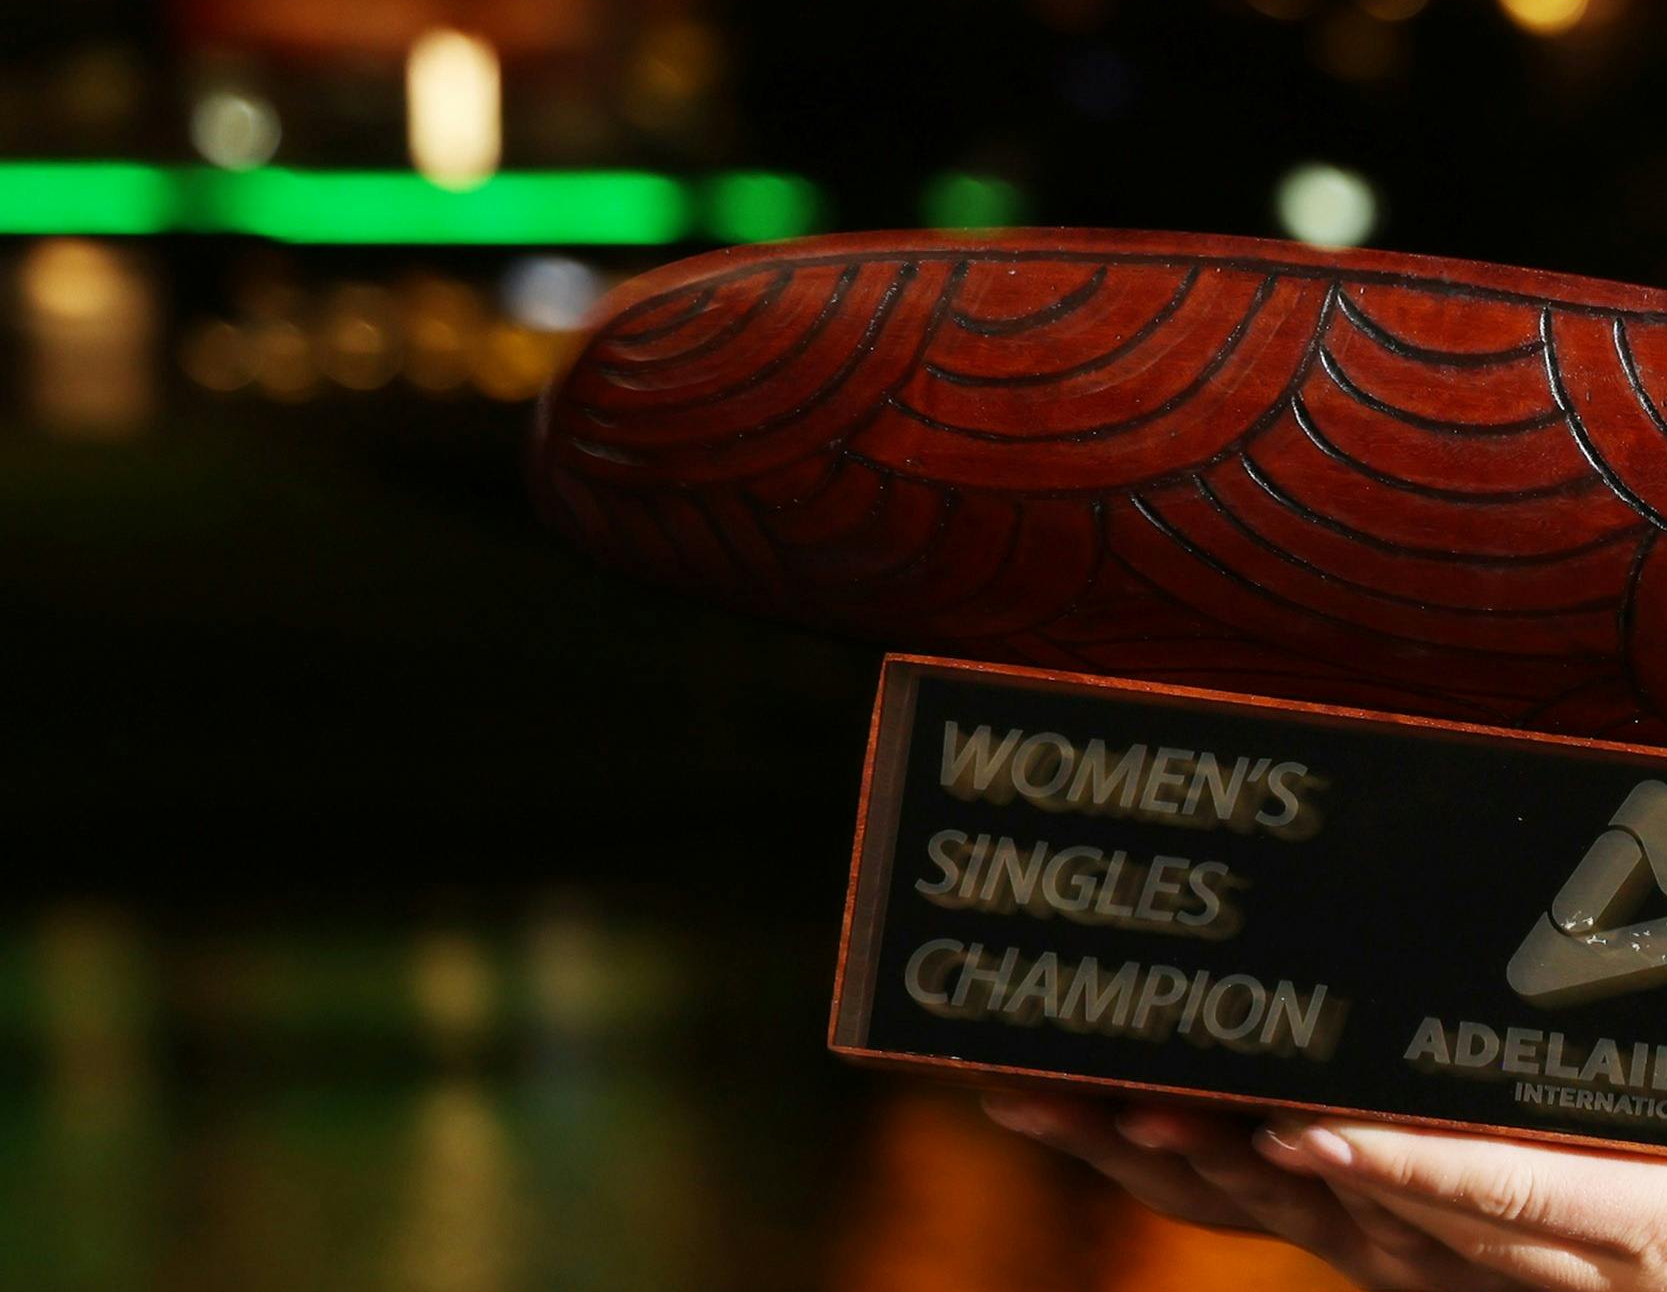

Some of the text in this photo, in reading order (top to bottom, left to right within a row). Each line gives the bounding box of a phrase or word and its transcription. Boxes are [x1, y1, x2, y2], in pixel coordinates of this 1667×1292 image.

[940, 720, 1309, 827] WOMEN'S
[914, 829, 1230, 927] SINGLES
[904, 938, 1329, 1049] CHAMPION
